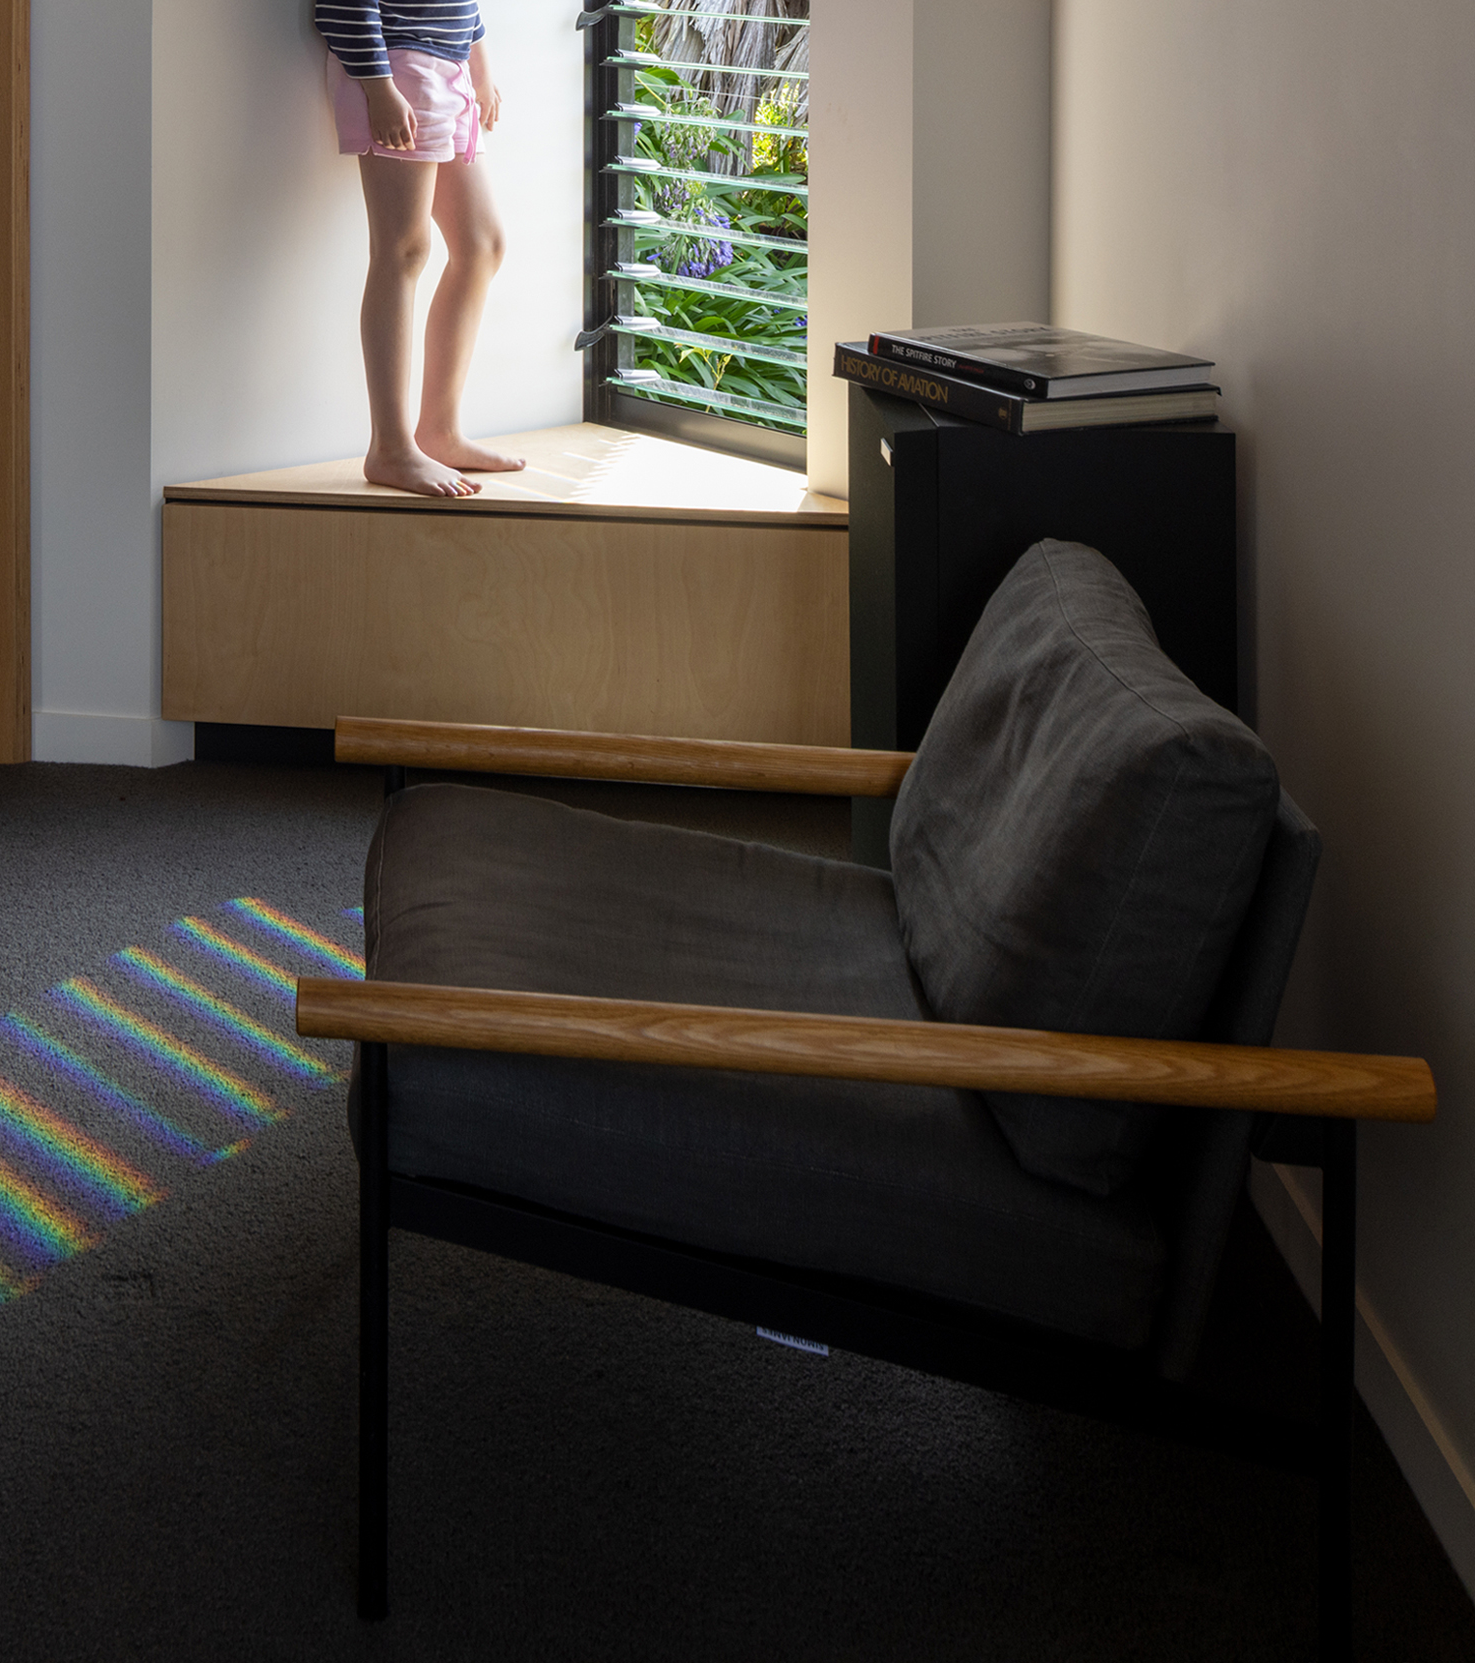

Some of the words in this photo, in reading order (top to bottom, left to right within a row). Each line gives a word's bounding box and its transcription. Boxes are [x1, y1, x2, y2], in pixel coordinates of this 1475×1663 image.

[891, 345, 904, 355] THE
[905, 348, 932, 363] SPITFIRE
[933, 355, 957, 368] STORY
[841, 355, 881, 381] HISTORY
[881, 368, 898, 385] OF
[897, 372, 949, 403] AVIATION
[793, 1336, 825, 1351] SIMON
